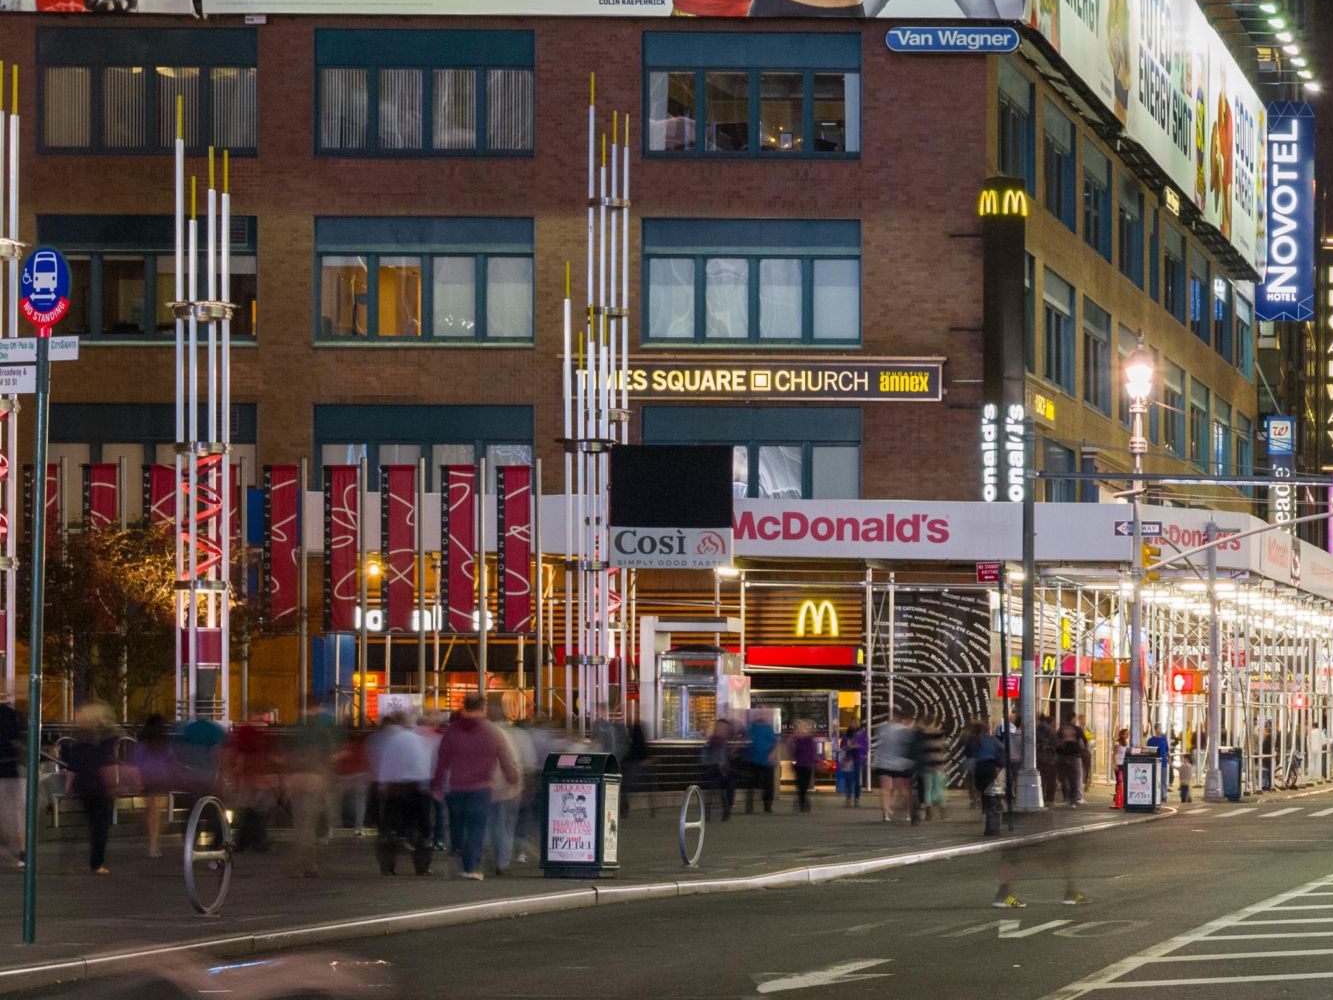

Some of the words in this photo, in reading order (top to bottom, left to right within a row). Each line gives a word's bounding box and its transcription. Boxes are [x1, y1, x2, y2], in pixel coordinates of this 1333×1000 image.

[897, 30, 935, 47] Van
[937, 29, 1012, 49] Wagner
[1139, 42, 1171, 137] ENERGY
[1173, 89, 1193, 162] SHOT
[1235, 95, 1254, 174] GOOD
[1267, 119, 1299, 294] NOVOTEL
[1267, 292, 1297, 302] HOTEL
[23, 301, 33, 316] NO
[32, 301, 66, 323] STANDING
[651, 369, 747, 392] SQUARE
[775, 370, 869, 392] CHURCH
[879, 375, 930, 392] annex
[732, 510, 950, 542] McDonald's
[614, 530, 687, 556] Così
[617, 559, 655, 567] SIMPLY
[658, 559, 689, 567] GOOD
